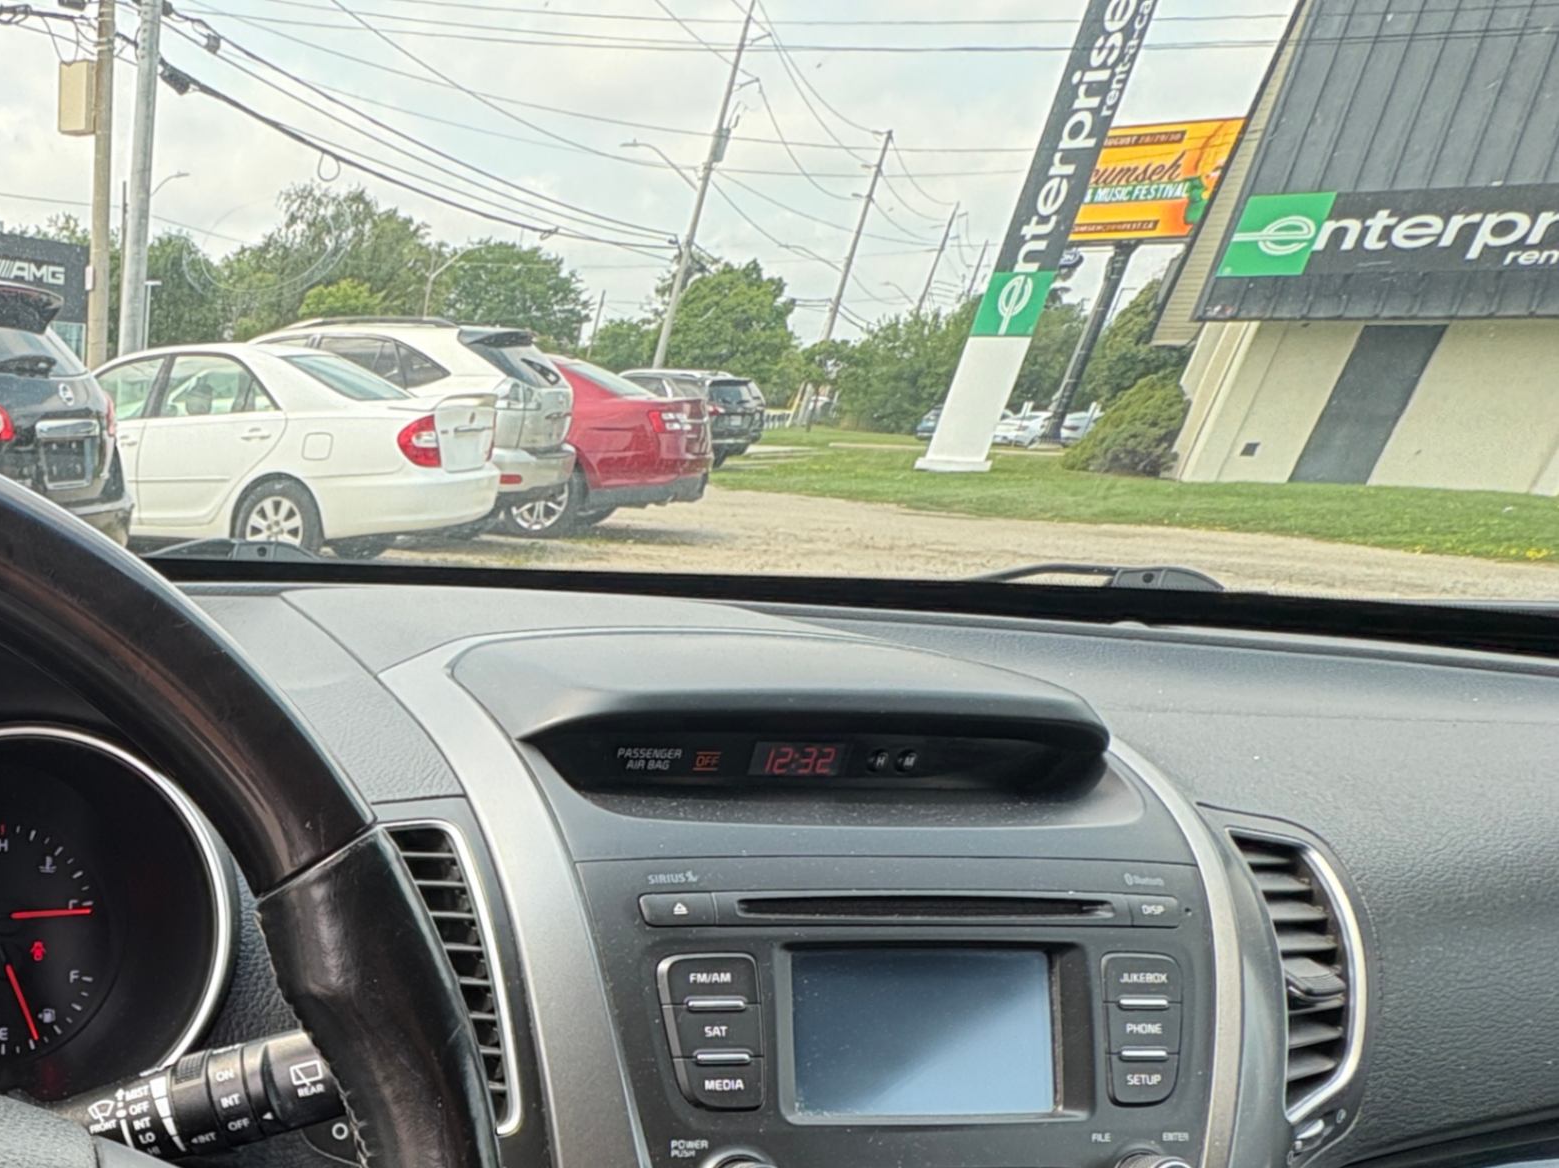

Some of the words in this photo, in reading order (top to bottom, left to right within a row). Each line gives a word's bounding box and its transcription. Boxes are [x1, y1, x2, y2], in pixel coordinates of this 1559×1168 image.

[1094, 186, 1133, 202] MUSIC
[1132, 182, 1190, 200] FESTIVAL
[617, 748, 683, 759] PASSENGER
[626, 760, 645, 770] AIR
[647, 760, 670, 770] BAG
[695, 755, 720, 767] OFF
[764, 747, 835, 774] 12:32
[69, 970, 79, 983] F
[689, 972, 732, 984] FM/AM
[1119, 971, 1168, 984] JUKEBOX
[704, 1026, 728, 1038] SAT
[1126, 1023, 1163, 1035] PHONE
[215, 1068, 235, 1082] ON
[1126, 1074, 1162, 1086] SETUP
[297, 1083, 325, 1098] REAR
[704, 1079, 744, 1092] MEDIA
[220, 1093, 240, 1109] INT
[129, 1101, 150, 1115] OFF
[89, 1119, 118, 1134] FRONT
[132, 1117, 151, 1131] INT
[227, 1117, 250, 1132] OFF
[139, 1132, 156, 1144] LO
[199, 1132, 217, 1144] INT
[1091, 1132, 1111, 1142] FILE
[1162, 1132, 1189, 1141] ENTER
[671, 1139, 709, 1149] POWER
